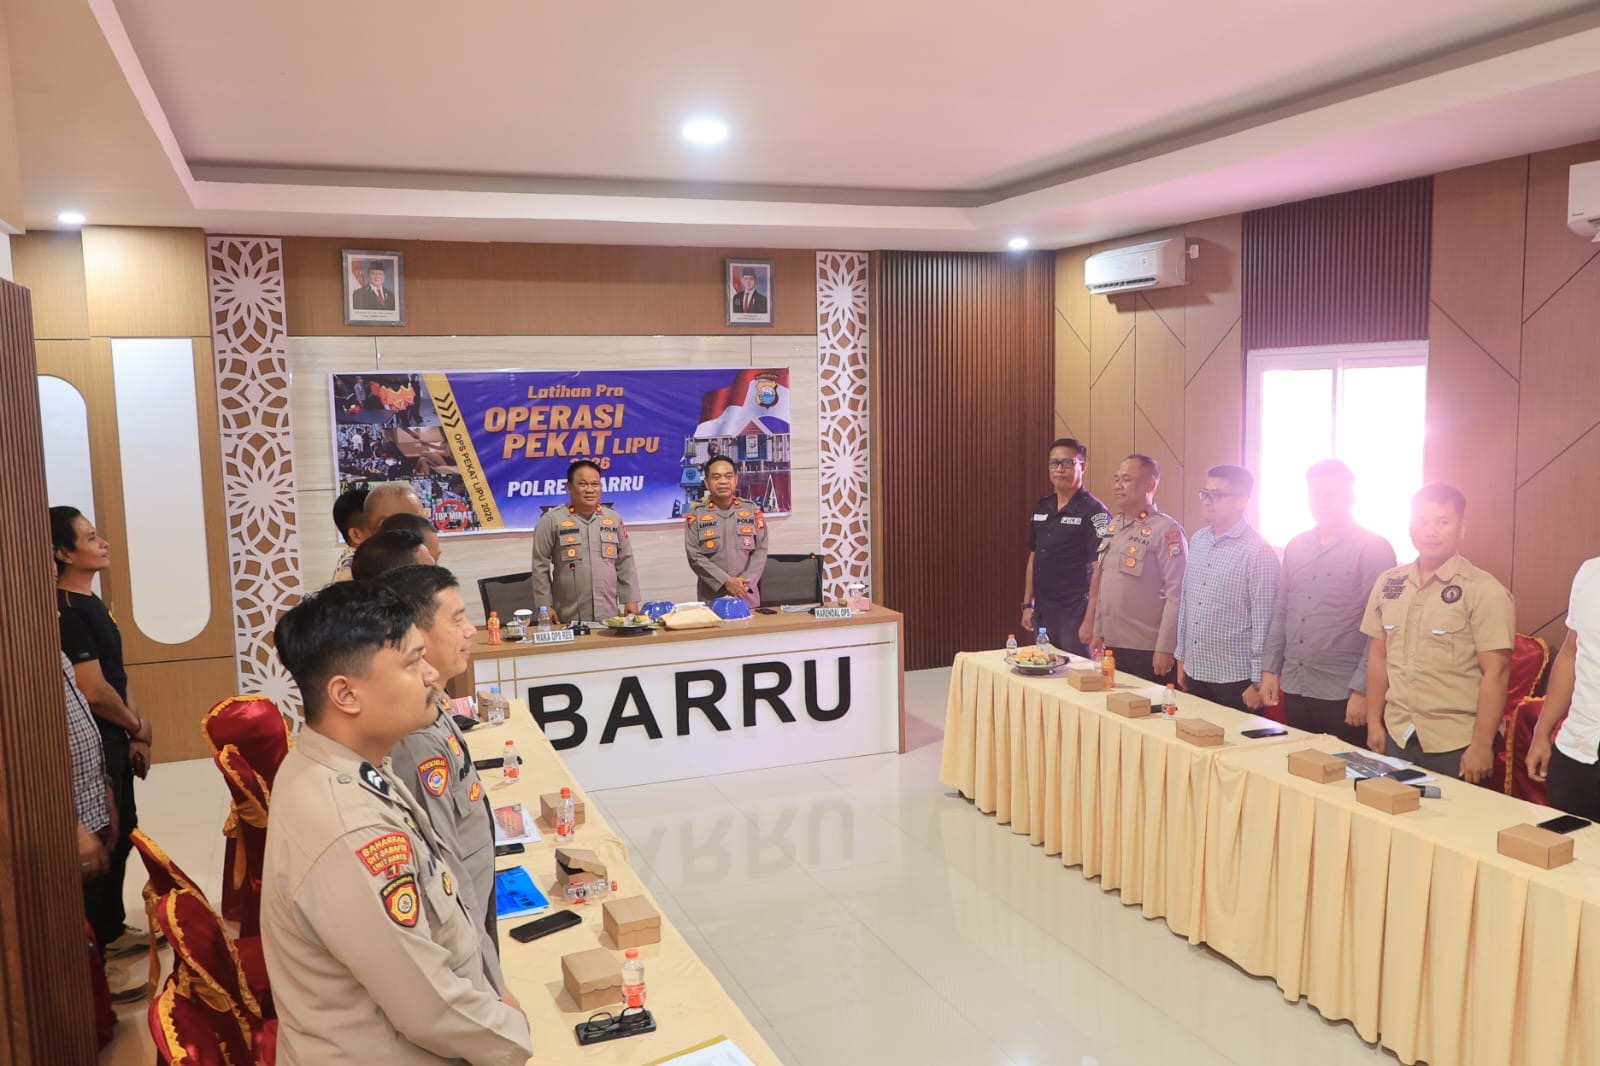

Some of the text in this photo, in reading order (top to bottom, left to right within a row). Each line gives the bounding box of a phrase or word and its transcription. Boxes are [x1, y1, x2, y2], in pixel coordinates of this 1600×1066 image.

[527, 383, 625, 399] Latihan Pra
[483, 403, 625, 433] OPERASI
[502, 430, 660, 459] PEKAT LIPU
[454, 433, 494, 522] OPS PEKAT LIPU 2026
[507, 475, 645, 498] POLRE ARRU
[551, 631, 562, 641] OPS
[528, 656, 851, 751] BARRU
